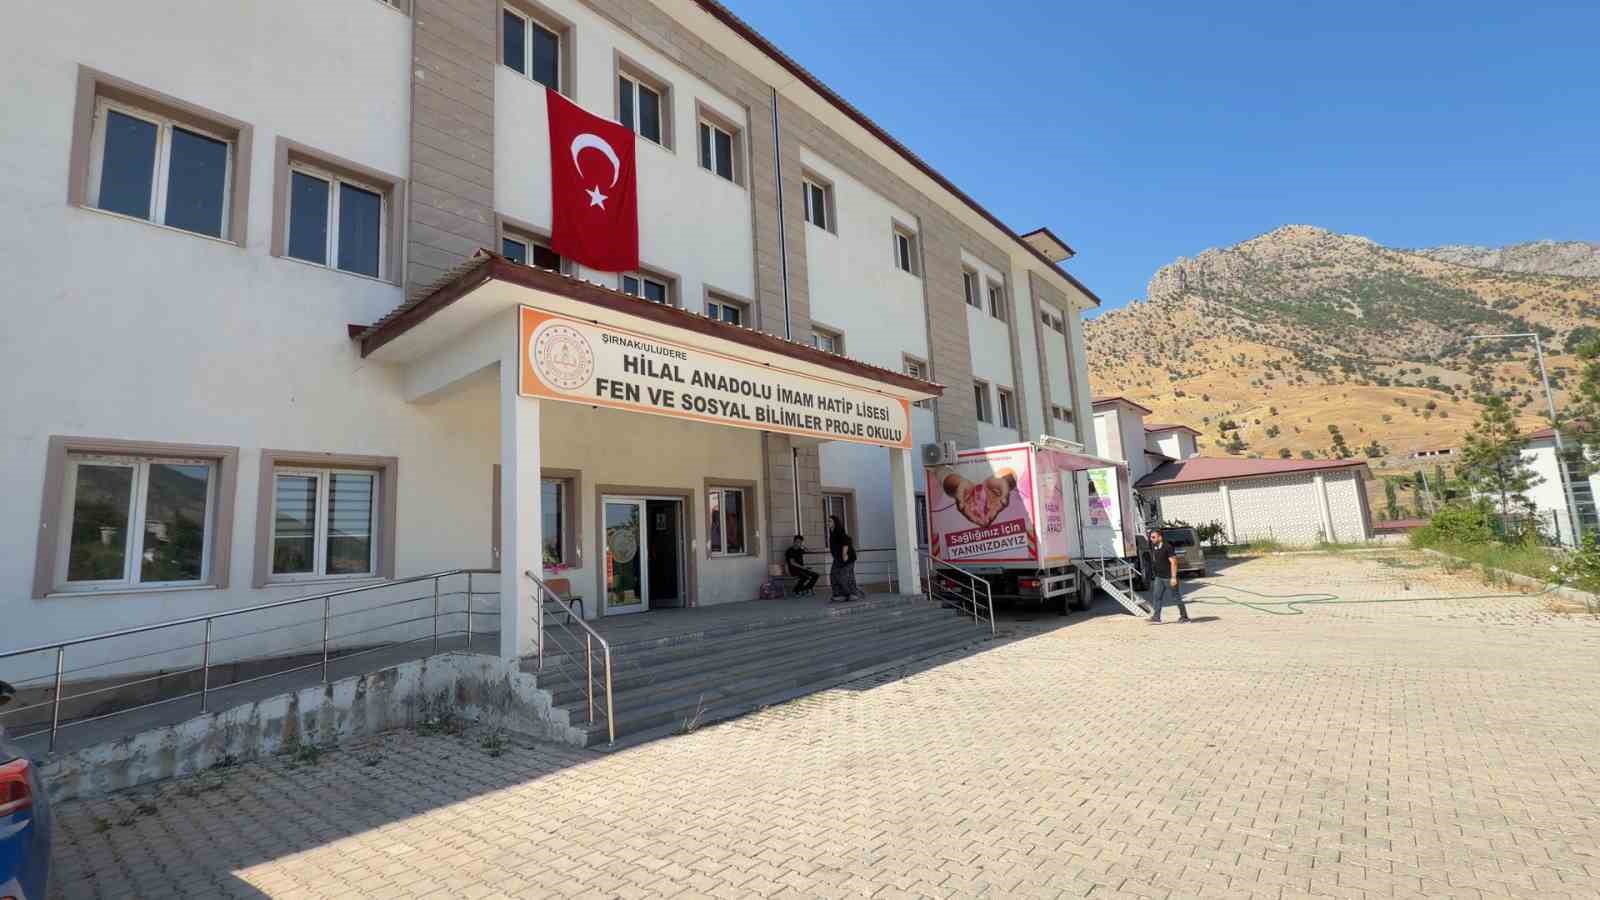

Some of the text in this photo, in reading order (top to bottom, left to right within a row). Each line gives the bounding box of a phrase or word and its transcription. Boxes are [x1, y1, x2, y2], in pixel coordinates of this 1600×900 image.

[602, 333, 687, 360] ŞIRNAK/ULUDERE
[624, 354, 889, 421] HİLAL ANADOLU İMAM HATİP LİSESİ
[596, 378, 902, 442] FEN VE SOSYAL BİLİMLER PROJE OKULU
[951, 526, 1000, 544] Sağlığınız
[951, 535, 1025, 556] YANINIZDAYIZ
